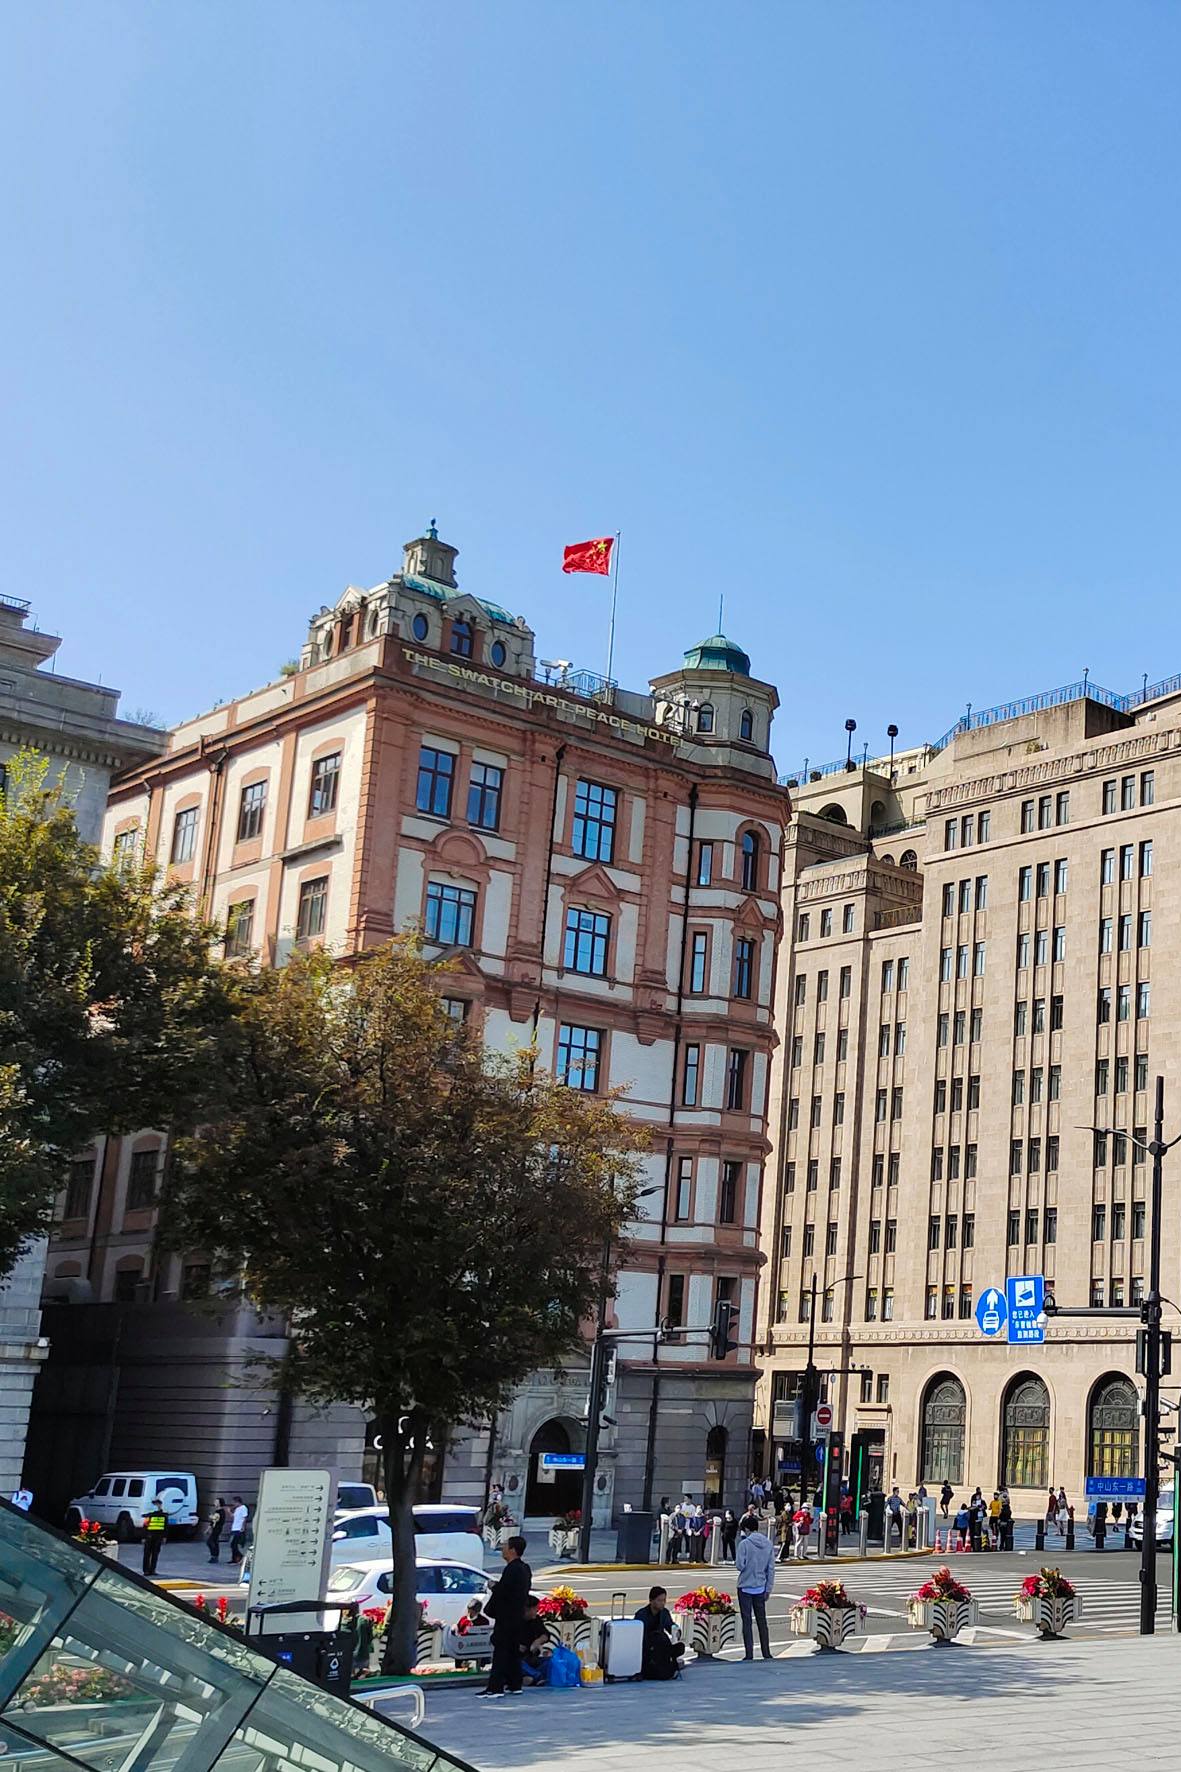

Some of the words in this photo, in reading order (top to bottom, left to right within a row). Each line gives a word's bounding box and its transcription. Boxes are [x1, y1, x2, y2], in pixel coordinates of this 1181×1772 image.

[401, 648, 441, 671] THE
[447, 662, 532, 700] SWATCH
[530, 690, 575, 714] ART
[574, 703, 633, 731] PEACE
[635, 723, 689, 750] HOTEL
